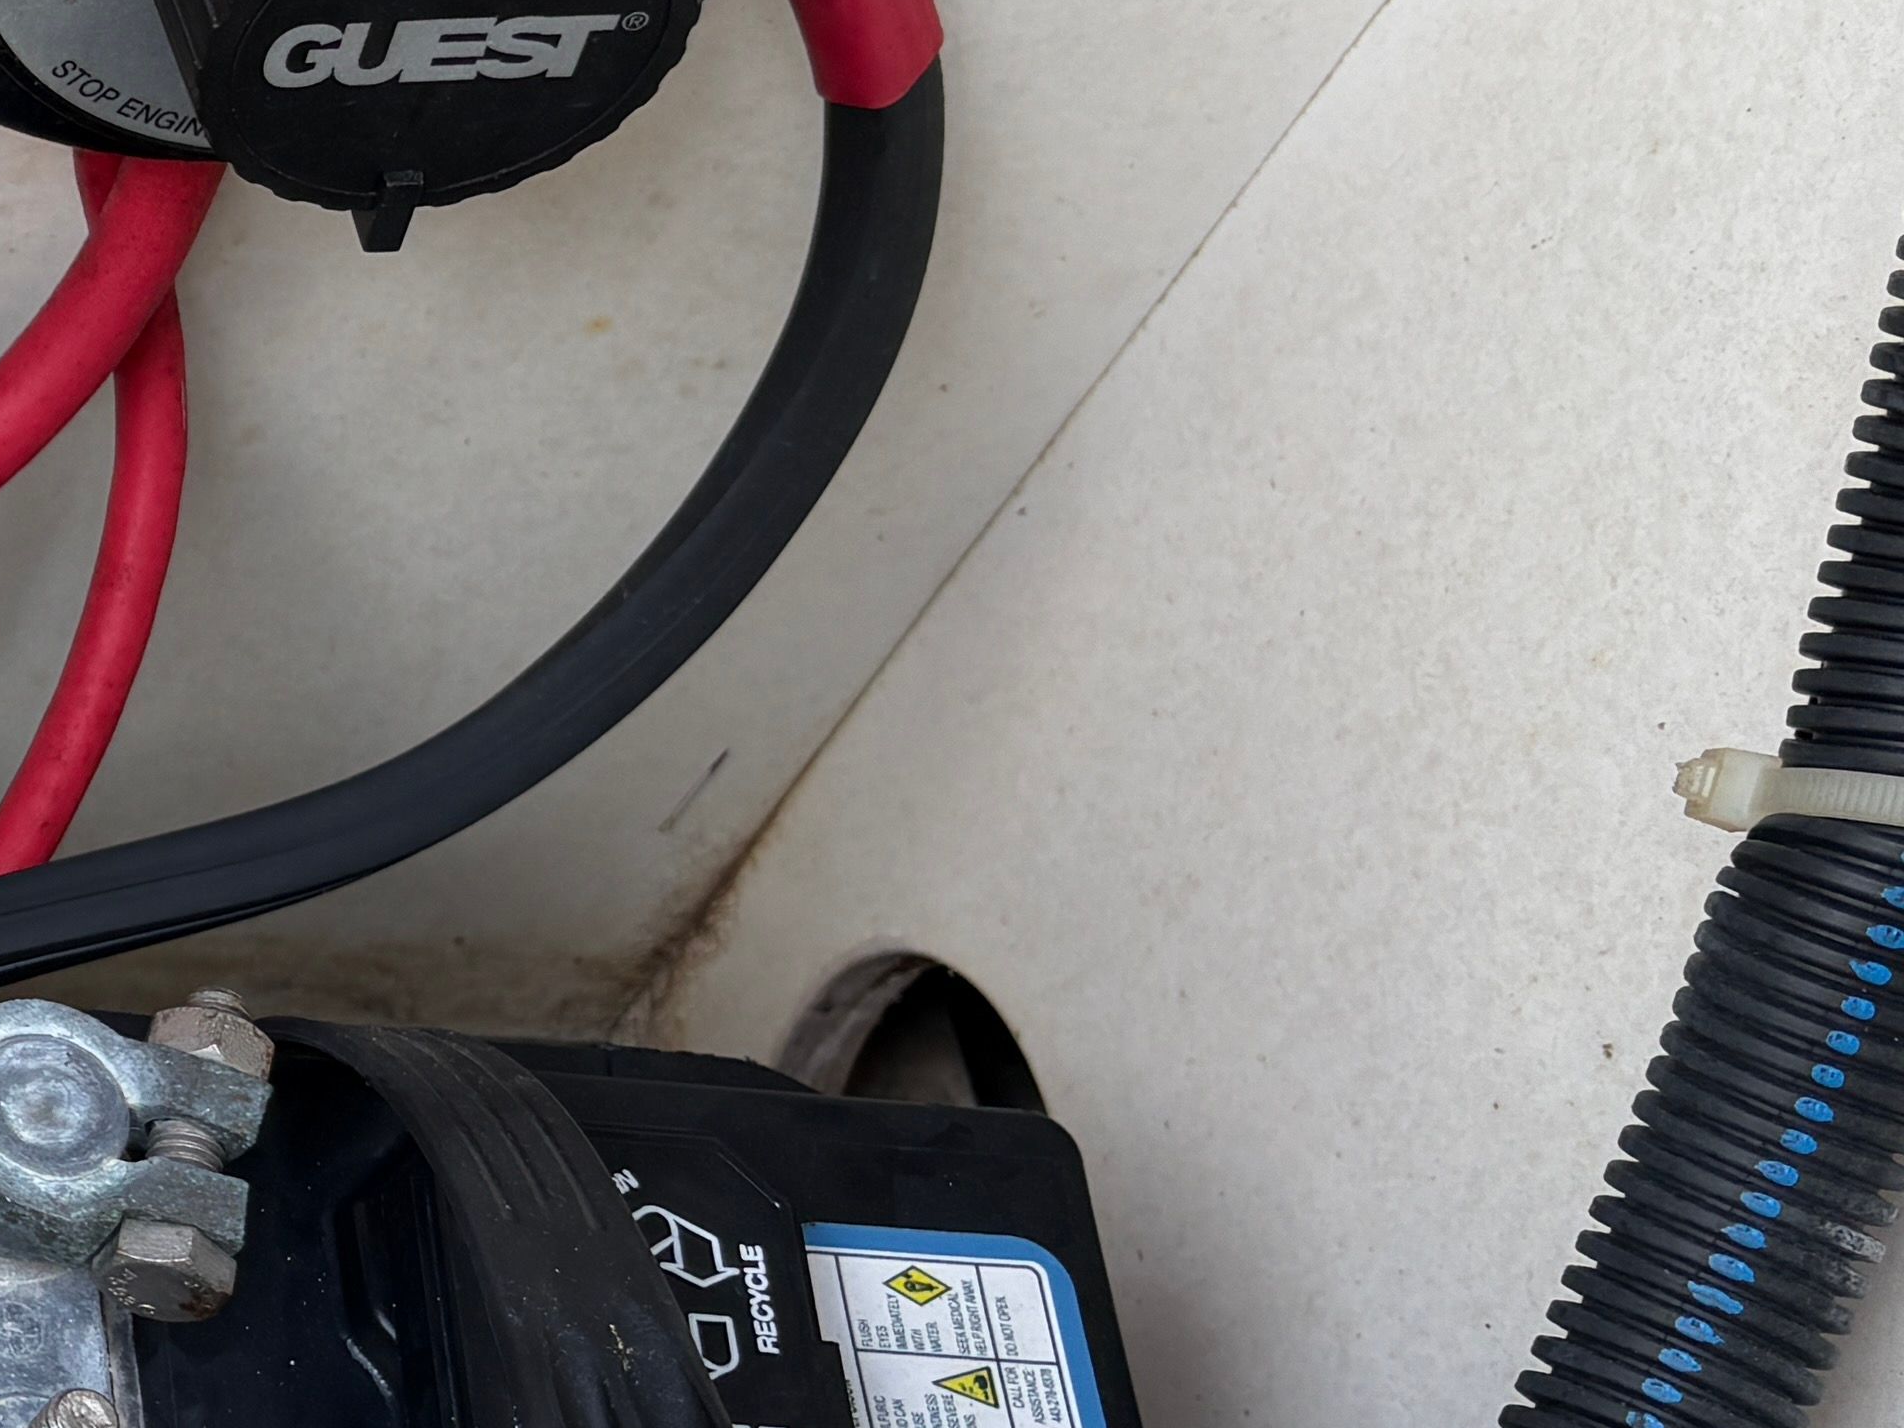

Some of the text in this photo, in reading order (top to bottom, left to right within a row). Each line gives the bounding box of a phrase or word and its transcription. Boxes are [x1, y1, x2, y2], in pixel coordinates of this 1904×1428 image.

[53, 59, 212, 140] STOP ENGIN
[739, 1241, 779, 1356] RECYCLE
